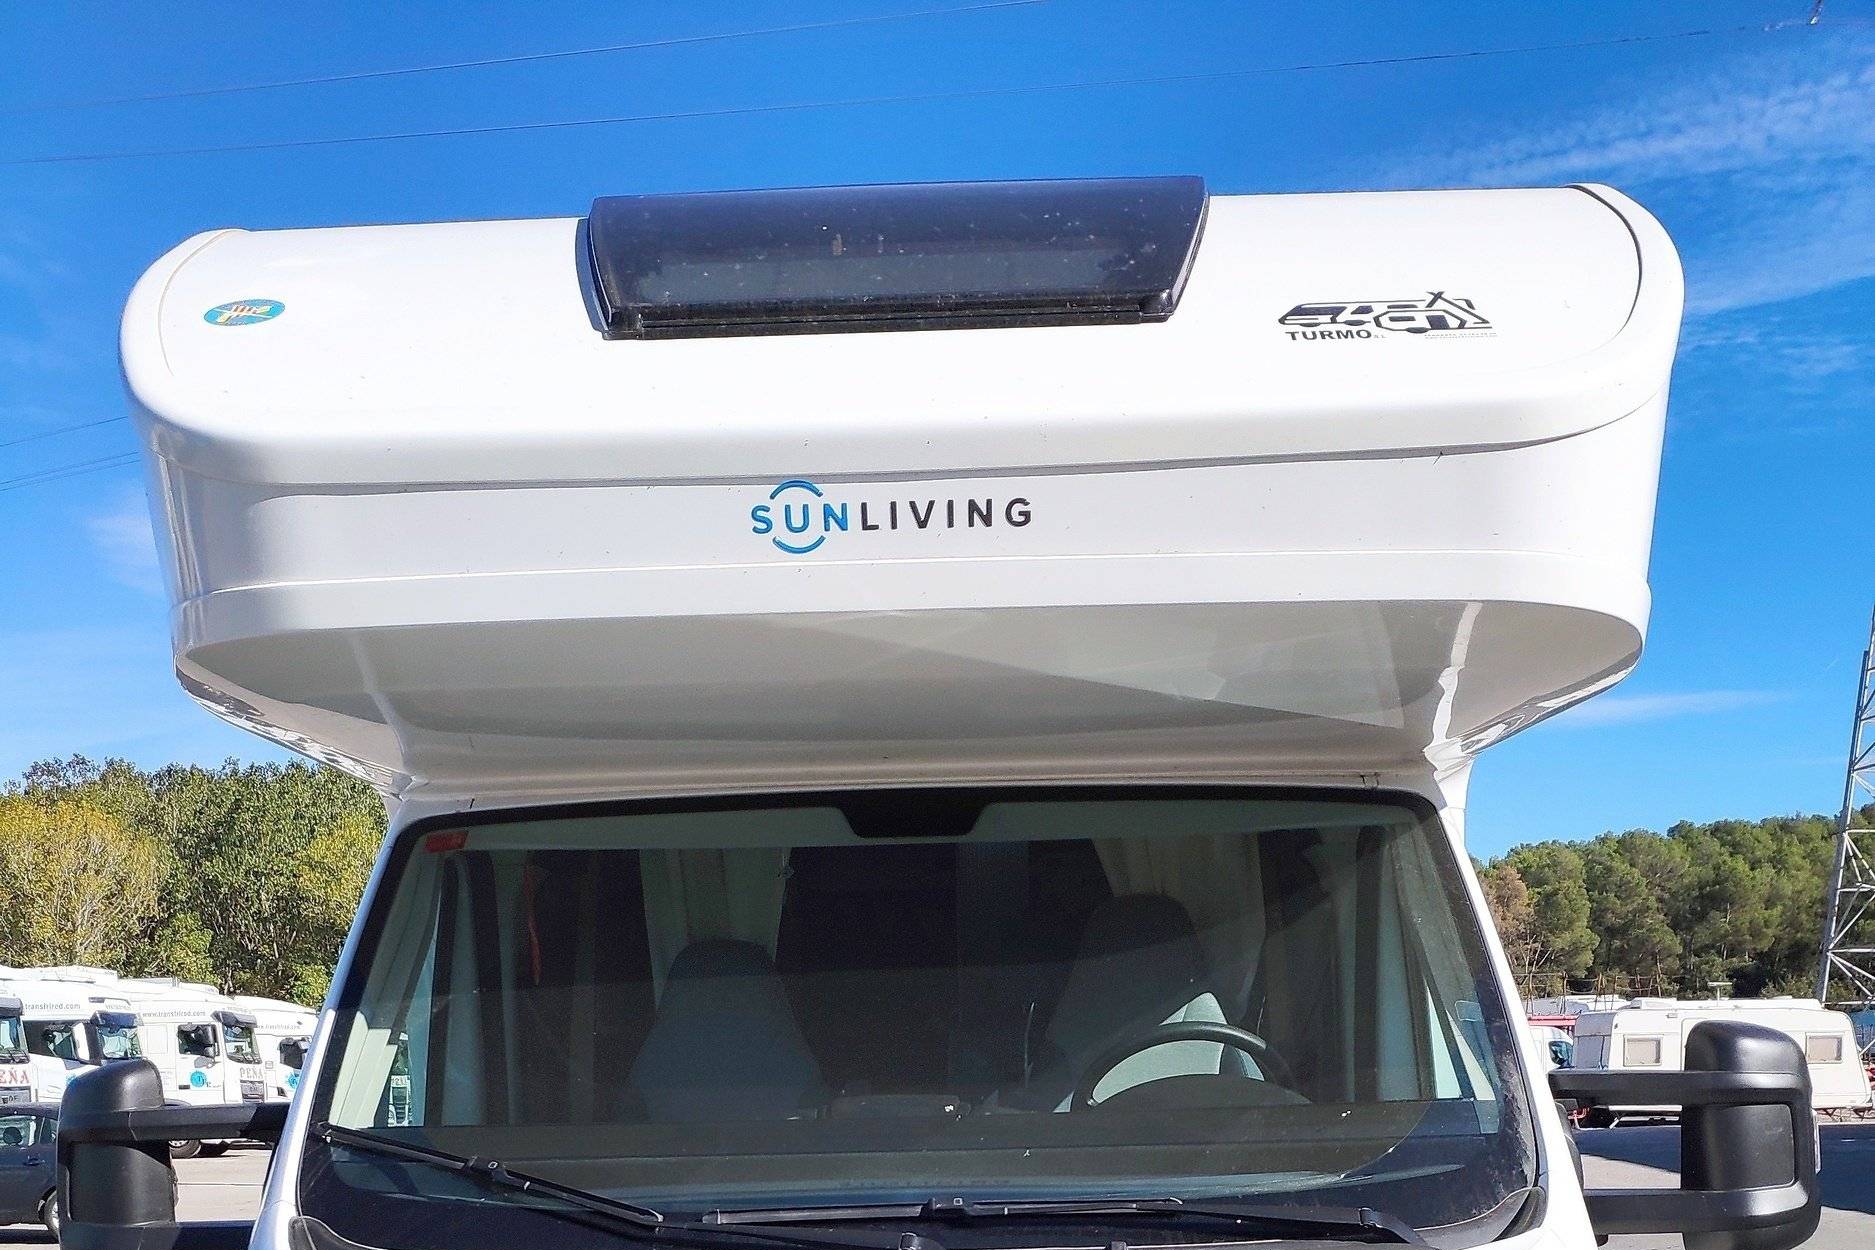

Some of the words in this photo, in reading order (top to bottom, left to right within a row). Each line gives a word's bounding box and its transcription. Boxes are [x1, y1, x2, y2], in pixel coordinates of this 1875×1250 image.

[1285, 329, 1372, 341] TURMO
[750, 497, 1033, 535] SUNLIVING
[0, 1067, 30, 1084] EÑA
